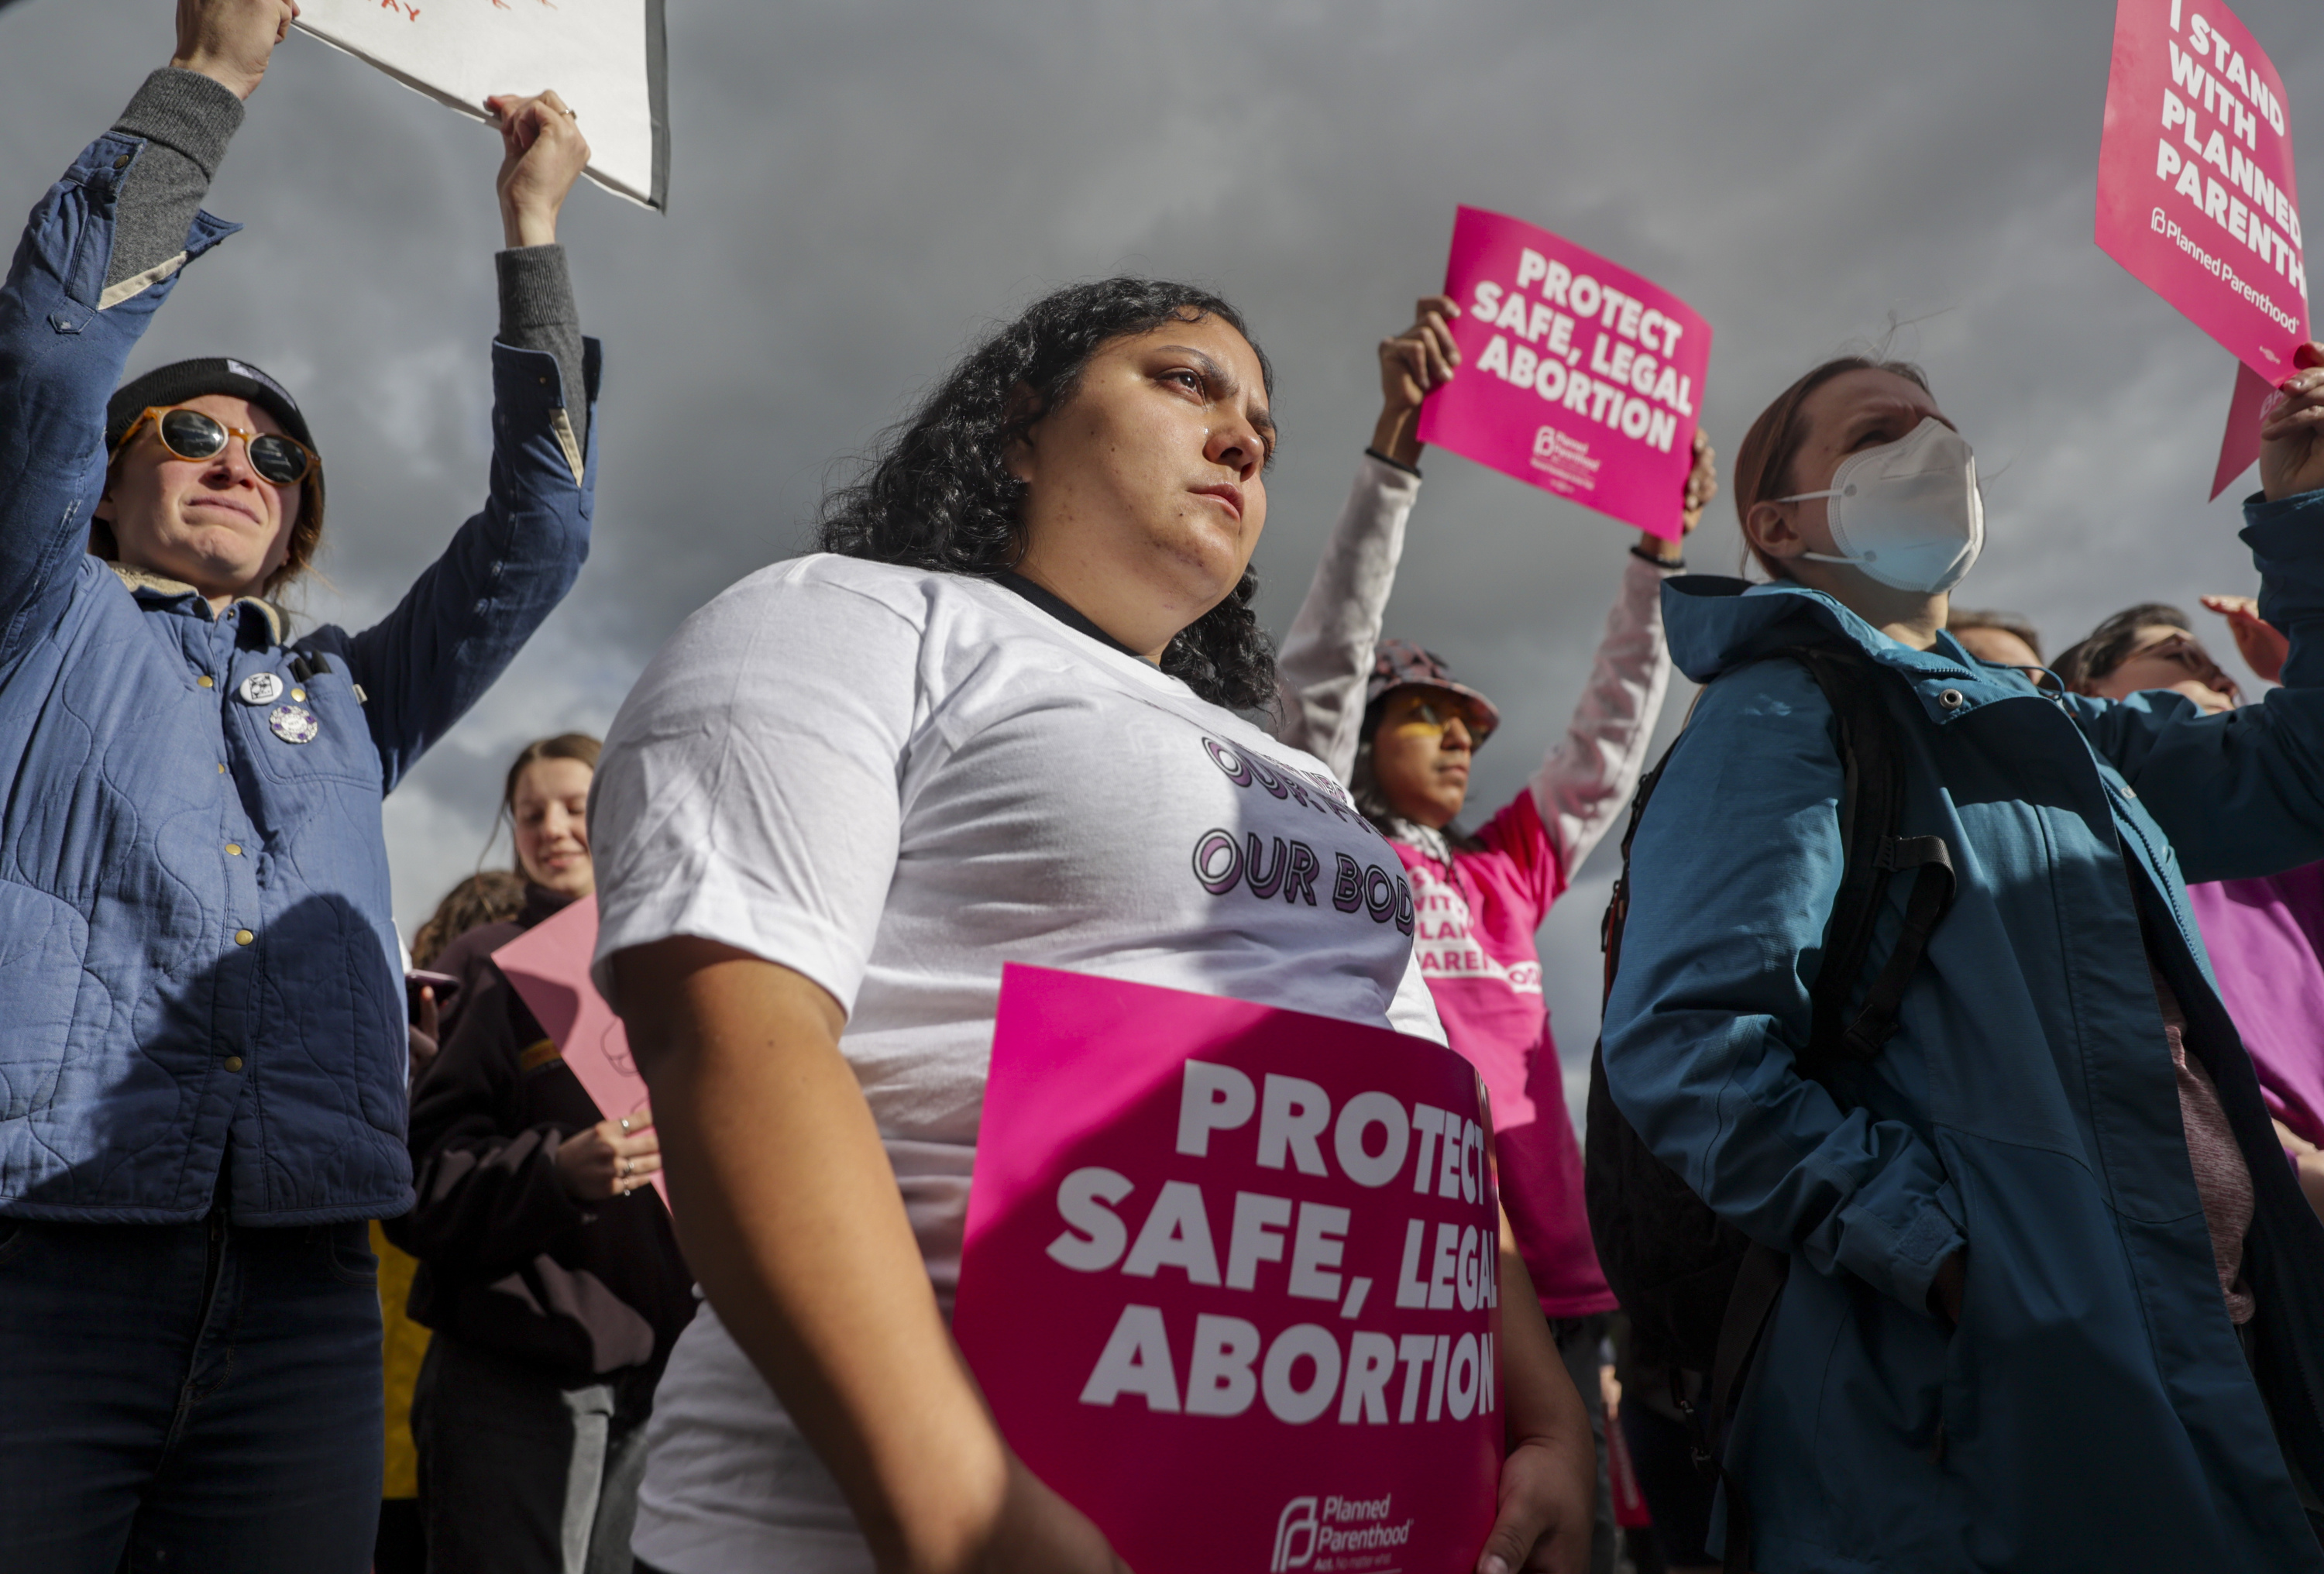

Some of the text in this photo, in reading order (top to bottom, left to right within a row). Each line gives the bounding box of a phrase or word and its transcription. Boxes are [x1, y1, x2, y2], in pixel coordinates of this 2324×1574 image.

[2168, 39, 2257, 152] WITH
[2169, 0, 2285, 138] I STAND
[2155, 138, 2308, 301] PARENTH
[2161, 87, 2302, 250] PLANNED
[1515, 247, 1684, 359] PROTECT
[2166, 219, 2298, 335] Planned Parenthood
[1470, 280, 1693, 418] SAFE, LEGAL
[1476, 333, 1678, 454] ABORTION
[1192, 827, 1320, 907] OUR
[1175, 1057, 1485, 1205] PROTECT
[1044, 1166, 1497, 1320] SAFE, LEGAL
[1078, 1303, 1495, 1425] ABORTION
[1318, 1517, 1411, 1553] Parenthood
[1322, 1492, 1392, 1523] Planned
